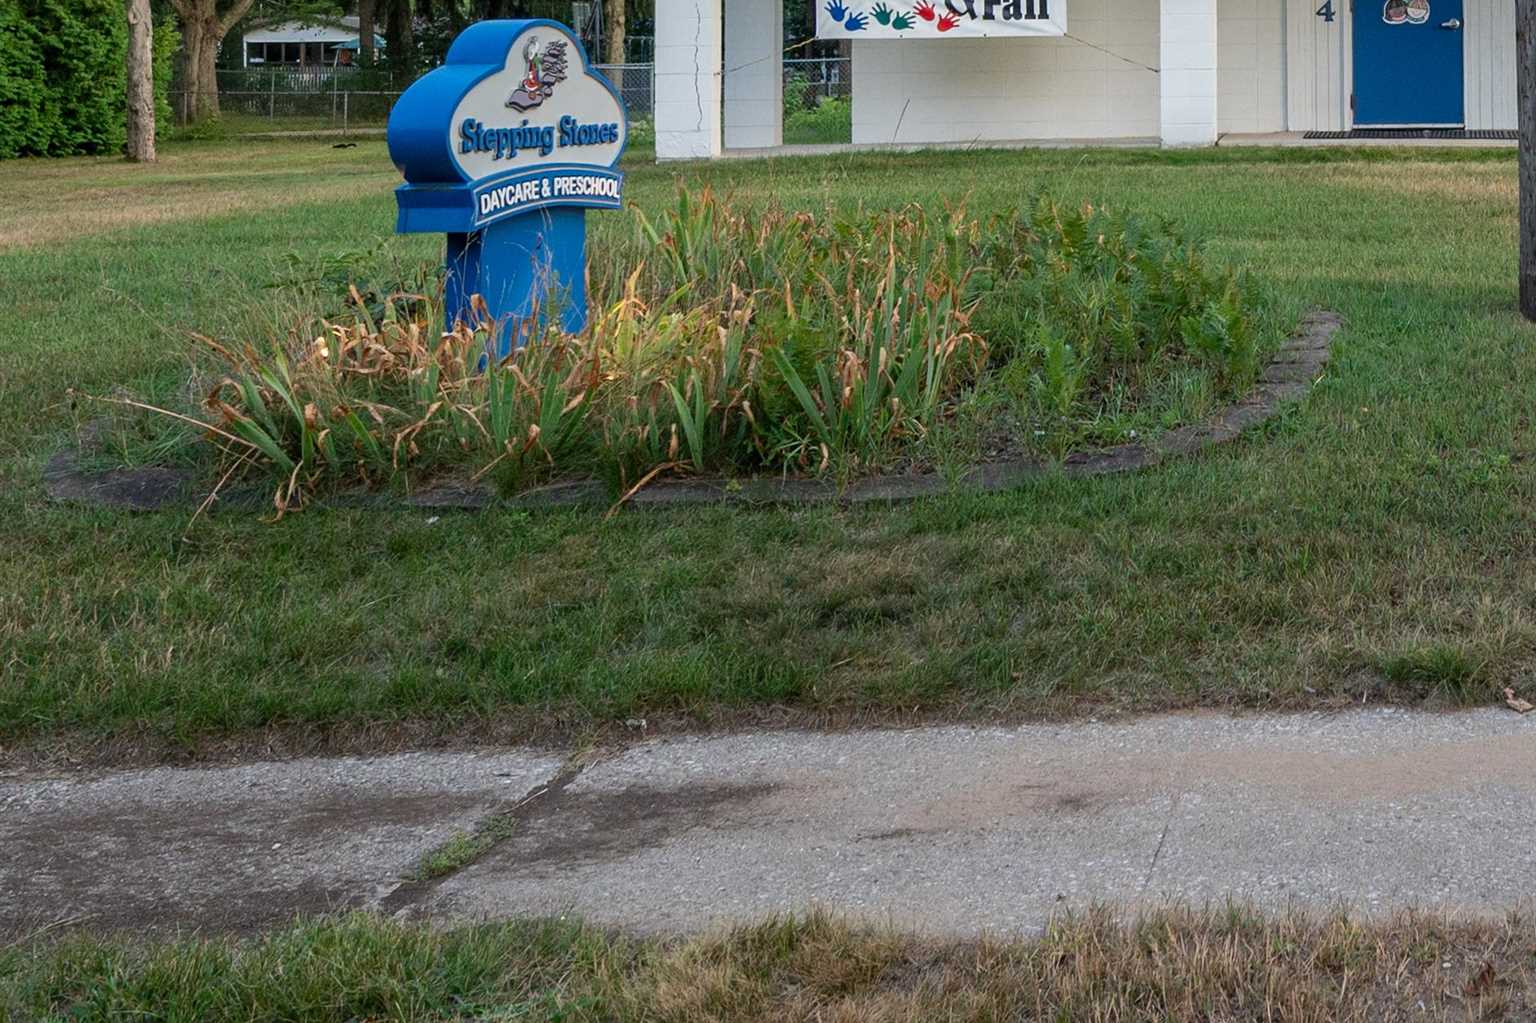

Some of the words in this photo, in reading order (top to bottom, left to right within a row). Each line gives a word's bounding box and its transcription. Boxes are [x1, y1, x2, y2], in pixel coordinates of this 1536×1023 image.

[459, 117, 555, 160] Stepping
[558, 114, 619, 148] Stones
[479, 179, 540, 215] DAYCARE
[541, 177, 551, 197] &
[553, 175, 621, 198] PRESCHOOL
